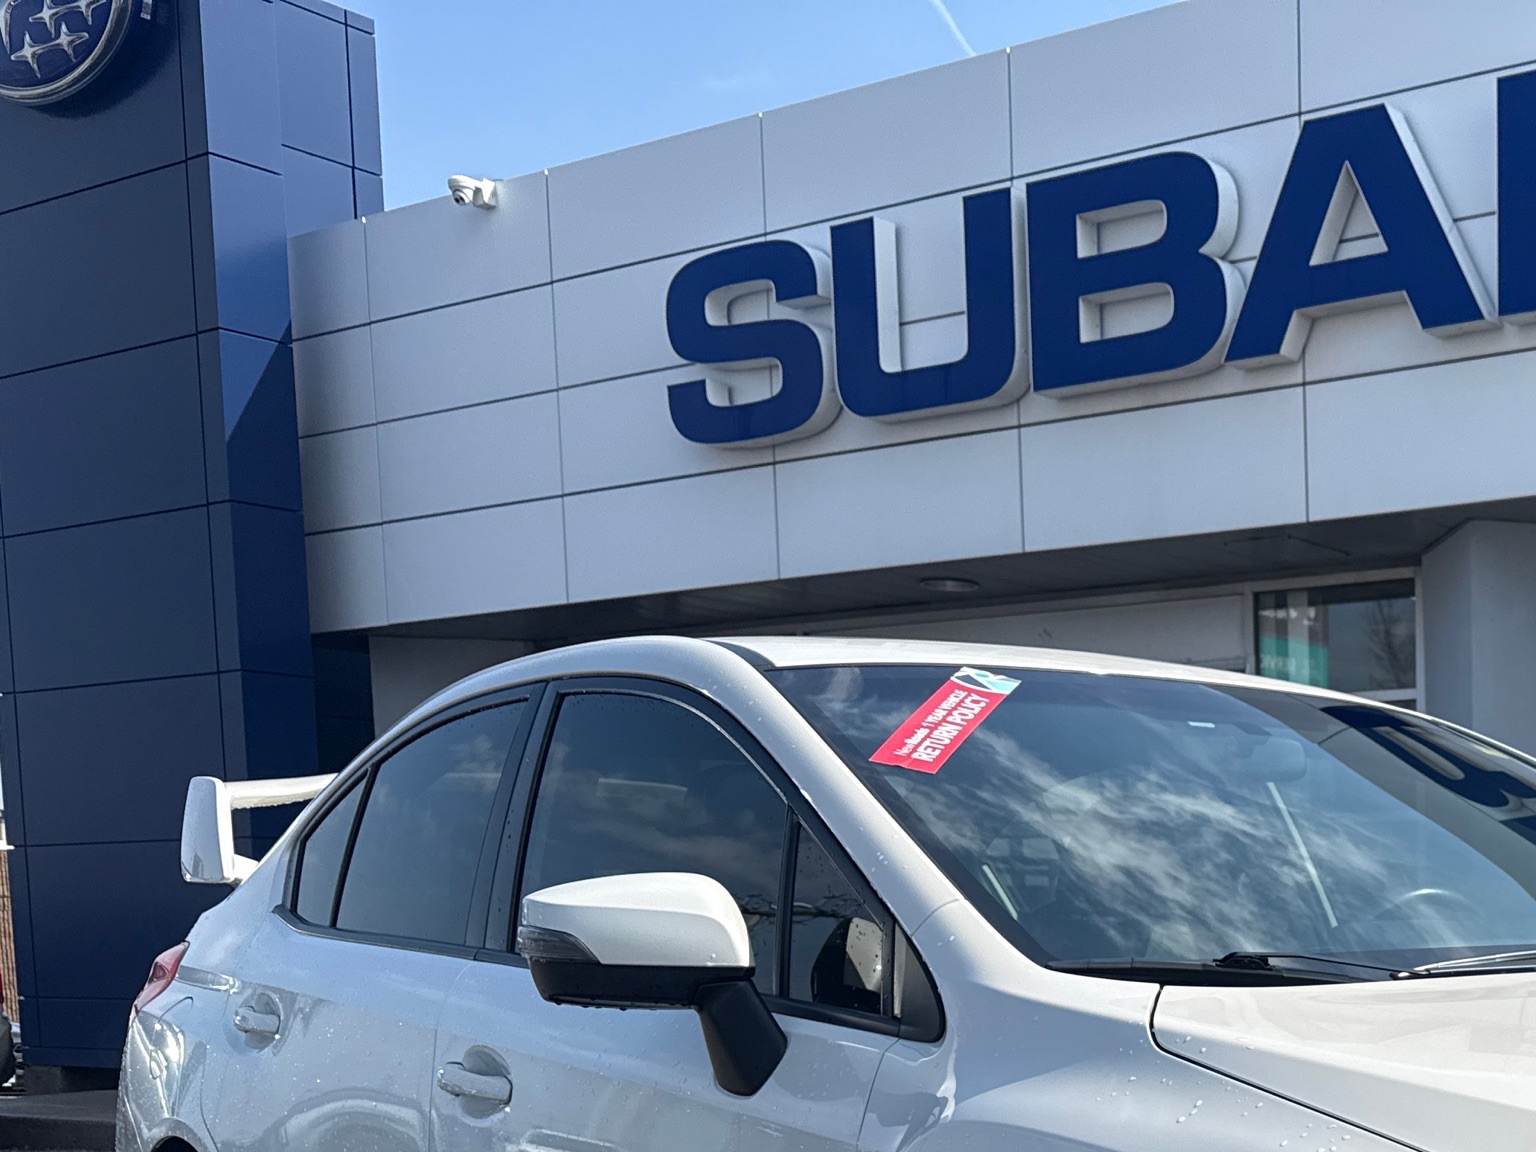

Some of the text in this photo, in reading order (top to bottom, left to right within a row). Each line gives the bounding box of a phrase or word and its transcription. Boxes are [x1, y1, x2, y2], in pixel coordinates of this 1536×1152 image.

[911, 693, 990, 762] RETURN POLICY
[924, 708, 949, 723] YEAR
[938, 689, 968, 710] VEHICLE
